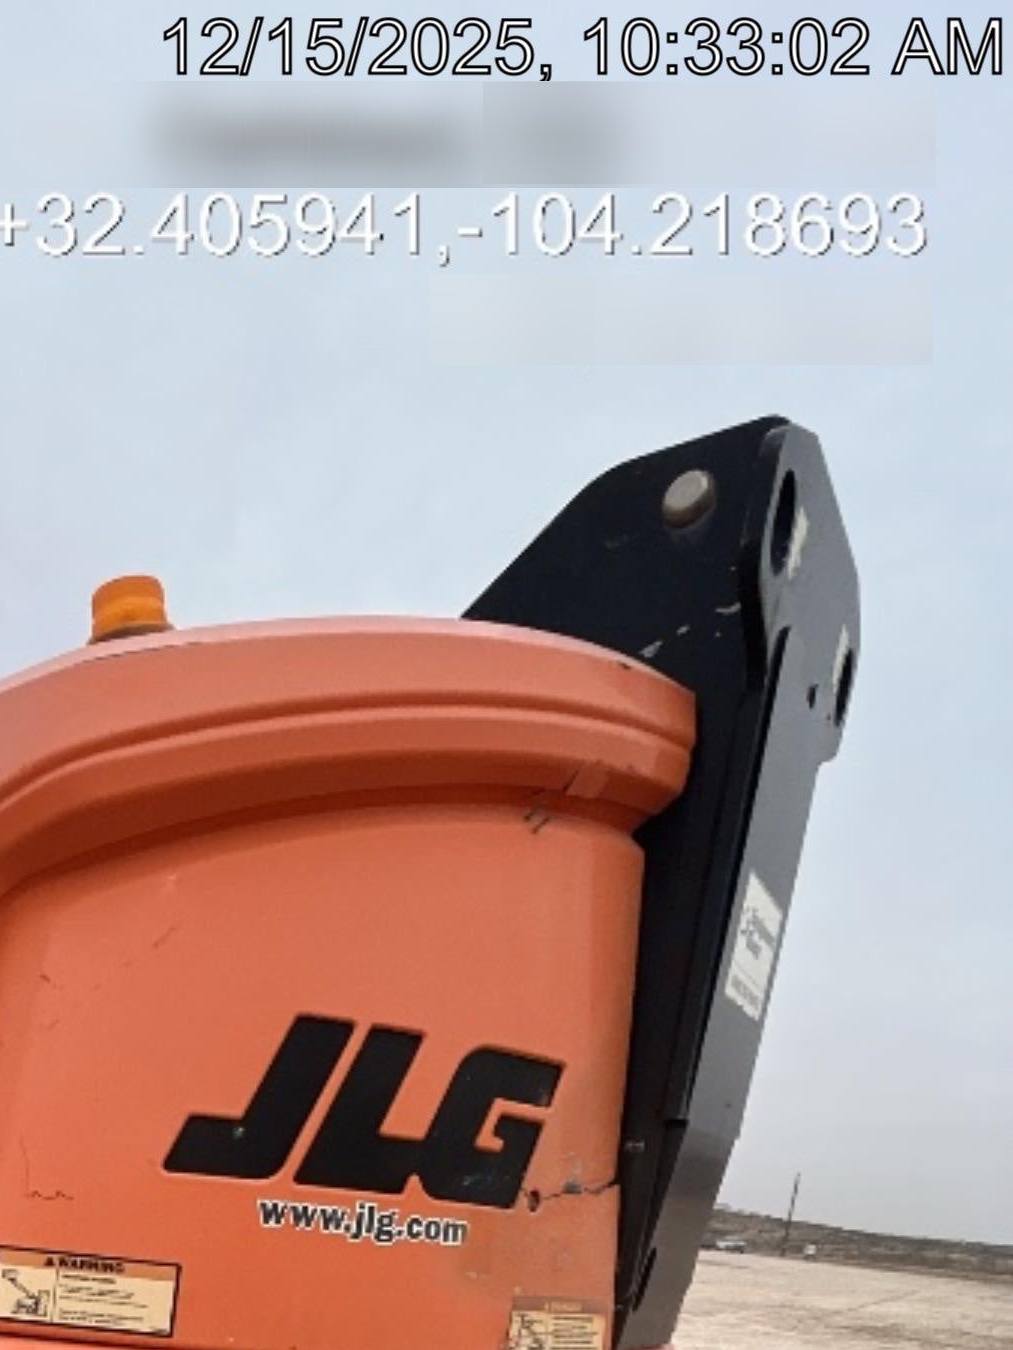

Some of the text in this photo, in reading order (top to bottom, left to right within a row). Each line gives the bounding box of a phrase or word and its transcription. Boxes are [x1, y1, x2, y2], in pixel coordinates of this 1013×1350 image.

[163, 1013, 566, 1210] JLG
[260, 1200, 469, 1245] www.jlg.com
[59, 1256, 125, 1274] WARNING
